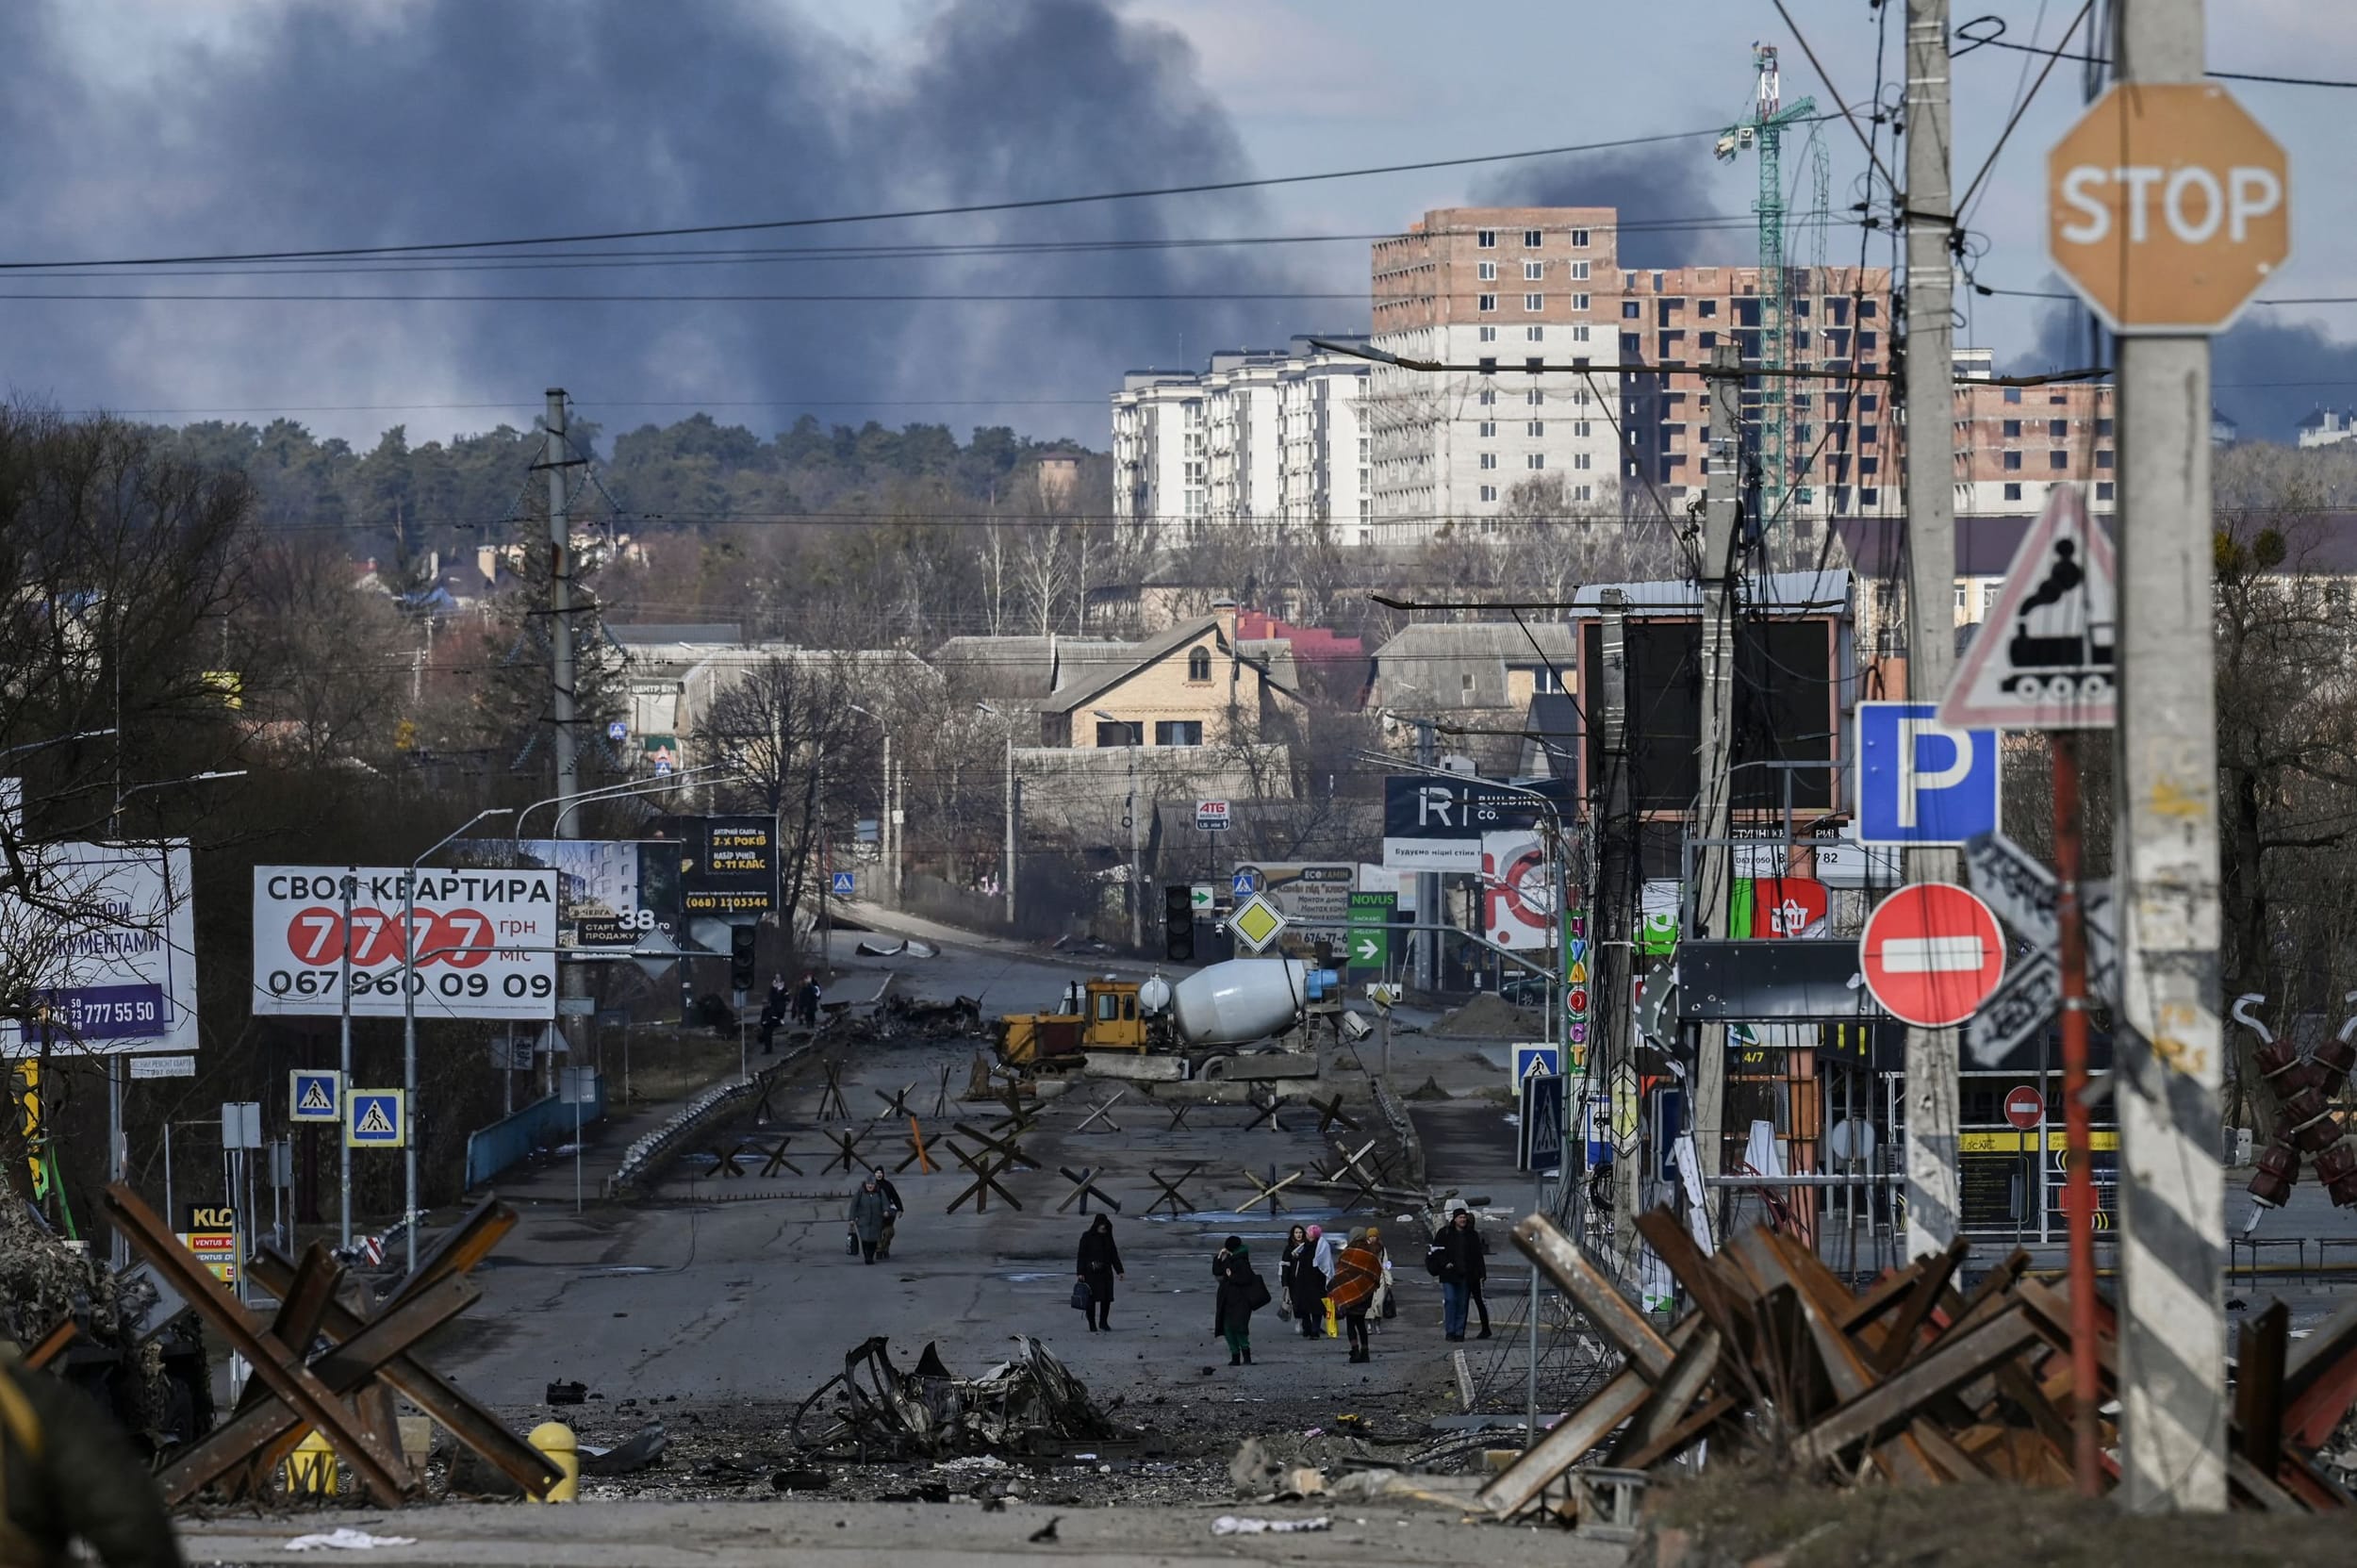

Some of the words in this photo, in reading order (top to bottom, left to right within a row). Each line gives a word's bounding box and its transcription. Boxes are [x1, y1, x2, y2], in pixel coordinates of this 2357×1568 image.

[2062, 166, 2281, 243] STOP
[1898, 718, 1973, 827] P
[738, 859, 766, 868] КЛАС
[268, 875, 357, 900] СВОЯ
[372, 876, 552, 902] КВАРТИРА
[1352, 895, 1394, 905] NOVUS
[500, 919, 536, 937] грн
[54, 931, 160, 956] КУМЕНТАМИ
[269, 970, 338, 995] 067
[350, 971, 424, 996] 960
[439, 972, 488, 998] 09
[503, 973, 552, 998] 09
[71, 999, 81, 1008] 50
[85, 1005, 111, 1023] 777
[115, 1002, 132, 1022] 55
[137, 1001, 154, 1020] 50
[1742, 1051, 1765, 1063] 4/7
[193, 1208, 232, 1227] KLO
